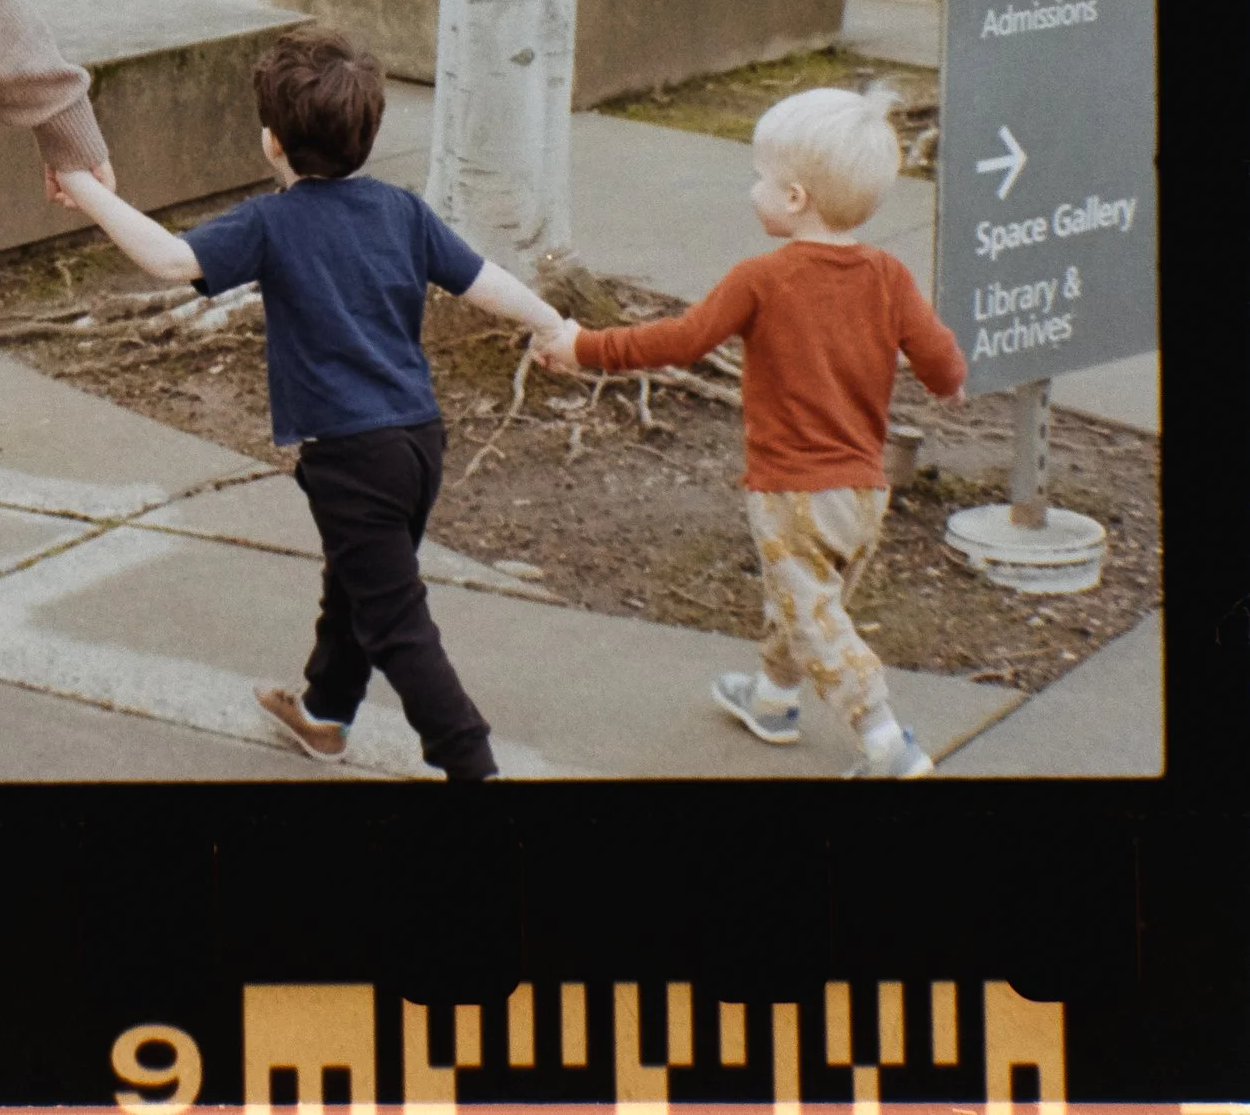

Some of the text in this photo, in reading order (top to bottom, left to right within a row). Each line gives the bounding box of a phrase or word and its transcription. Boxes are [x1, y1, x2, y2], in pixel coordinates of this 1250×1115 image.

[974, 193, 1139, 261] Space Gallery
[973, 264, 1081, 321] Library &
[971, 311, 1074, 361] Archives
[110, 1021, 203, 1115] 9
